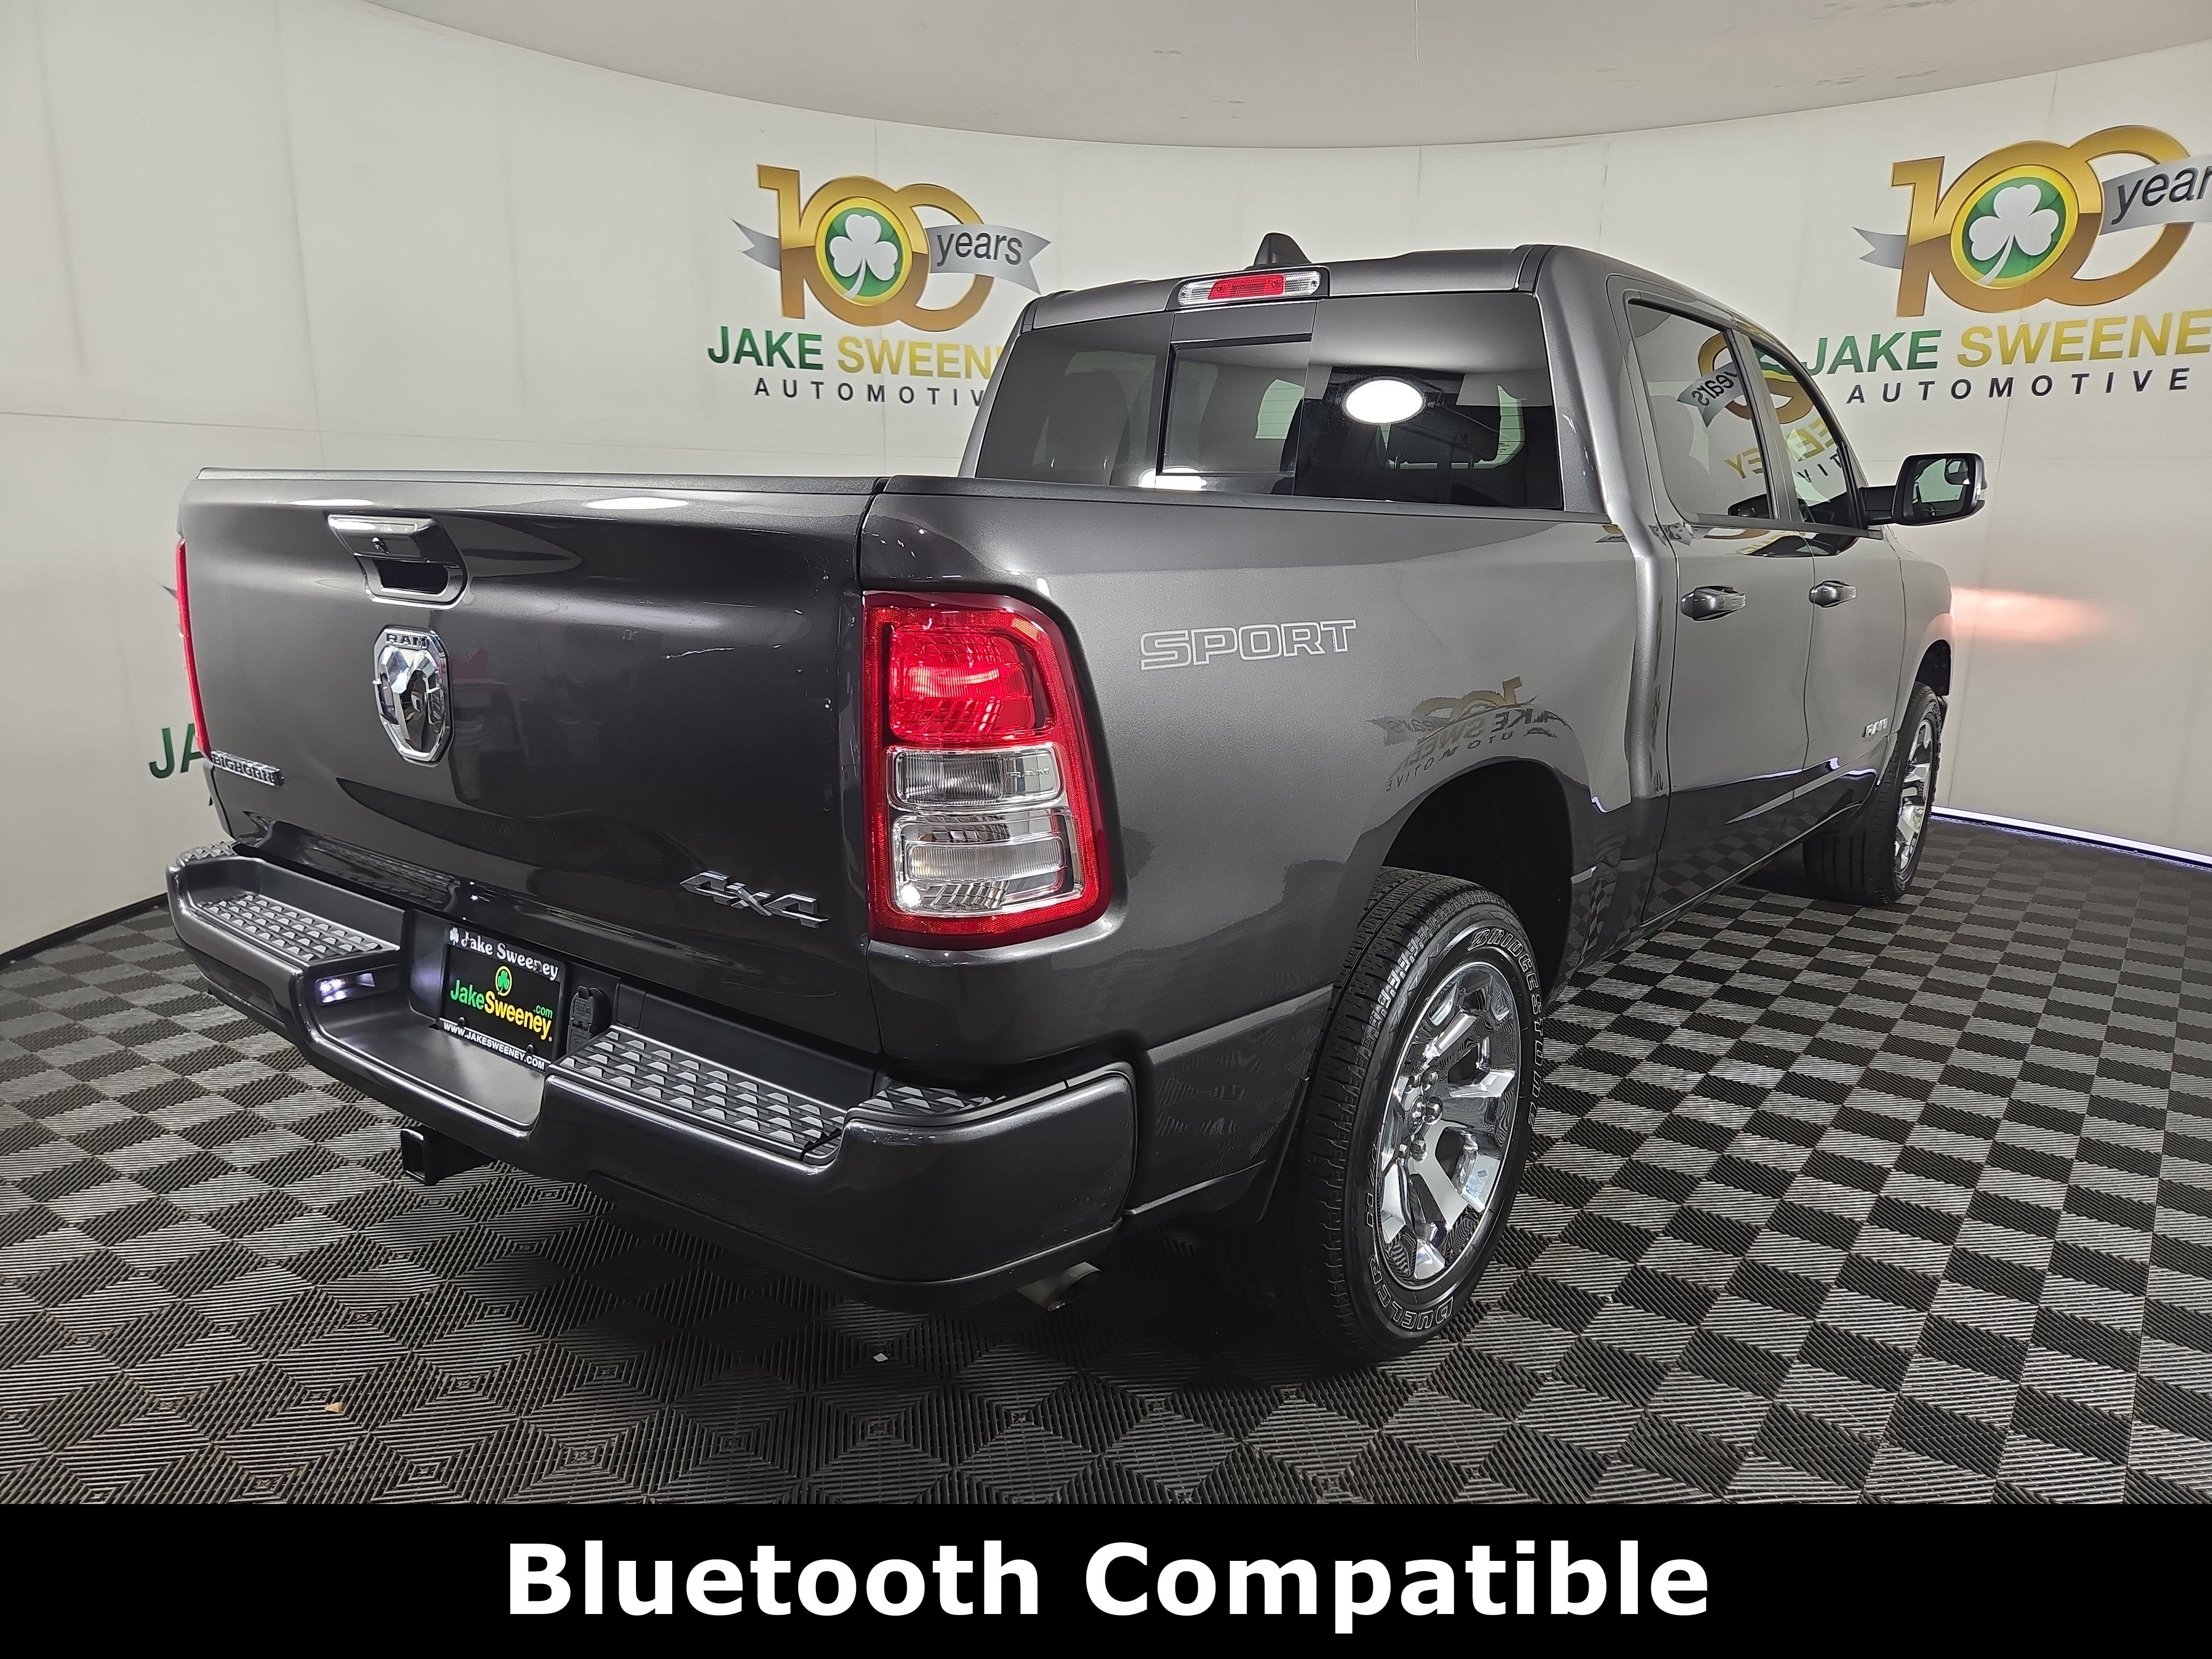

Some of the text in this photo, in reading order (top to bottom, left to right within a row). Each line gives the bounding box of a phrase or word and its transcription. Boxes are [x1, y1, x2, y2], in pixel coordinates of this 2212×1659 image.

[1891, 124, 2212, 318] 100 year
[756, 164, 1023, 332] 100 years
[708, 326, 1004, 380] JAKE SWEEN
[1801, 308, 2212, 376] JAKE SWEENE
[754, 378, 985, 407] AUTOMOTIV
[1846, 367, 2190, 404] AUTOMOTIVE
[386, 633, 430, 650] RAM
[1140, 619, 1357, 671] SPORT
[149, 723, 204, 779] JA
[1863, 717, 1888, 737] RAM
[1007, 768, 1050, 777] RAM
[461, 931, 559, 981] Jake Sweeney
[443, 1021, 545, 1070] WWW.JAKESWEENEY.COM
[1467, 928, 1543, 1131] BRIDGESTONE
[1369, 1256, 1454, 1330] DUELER
